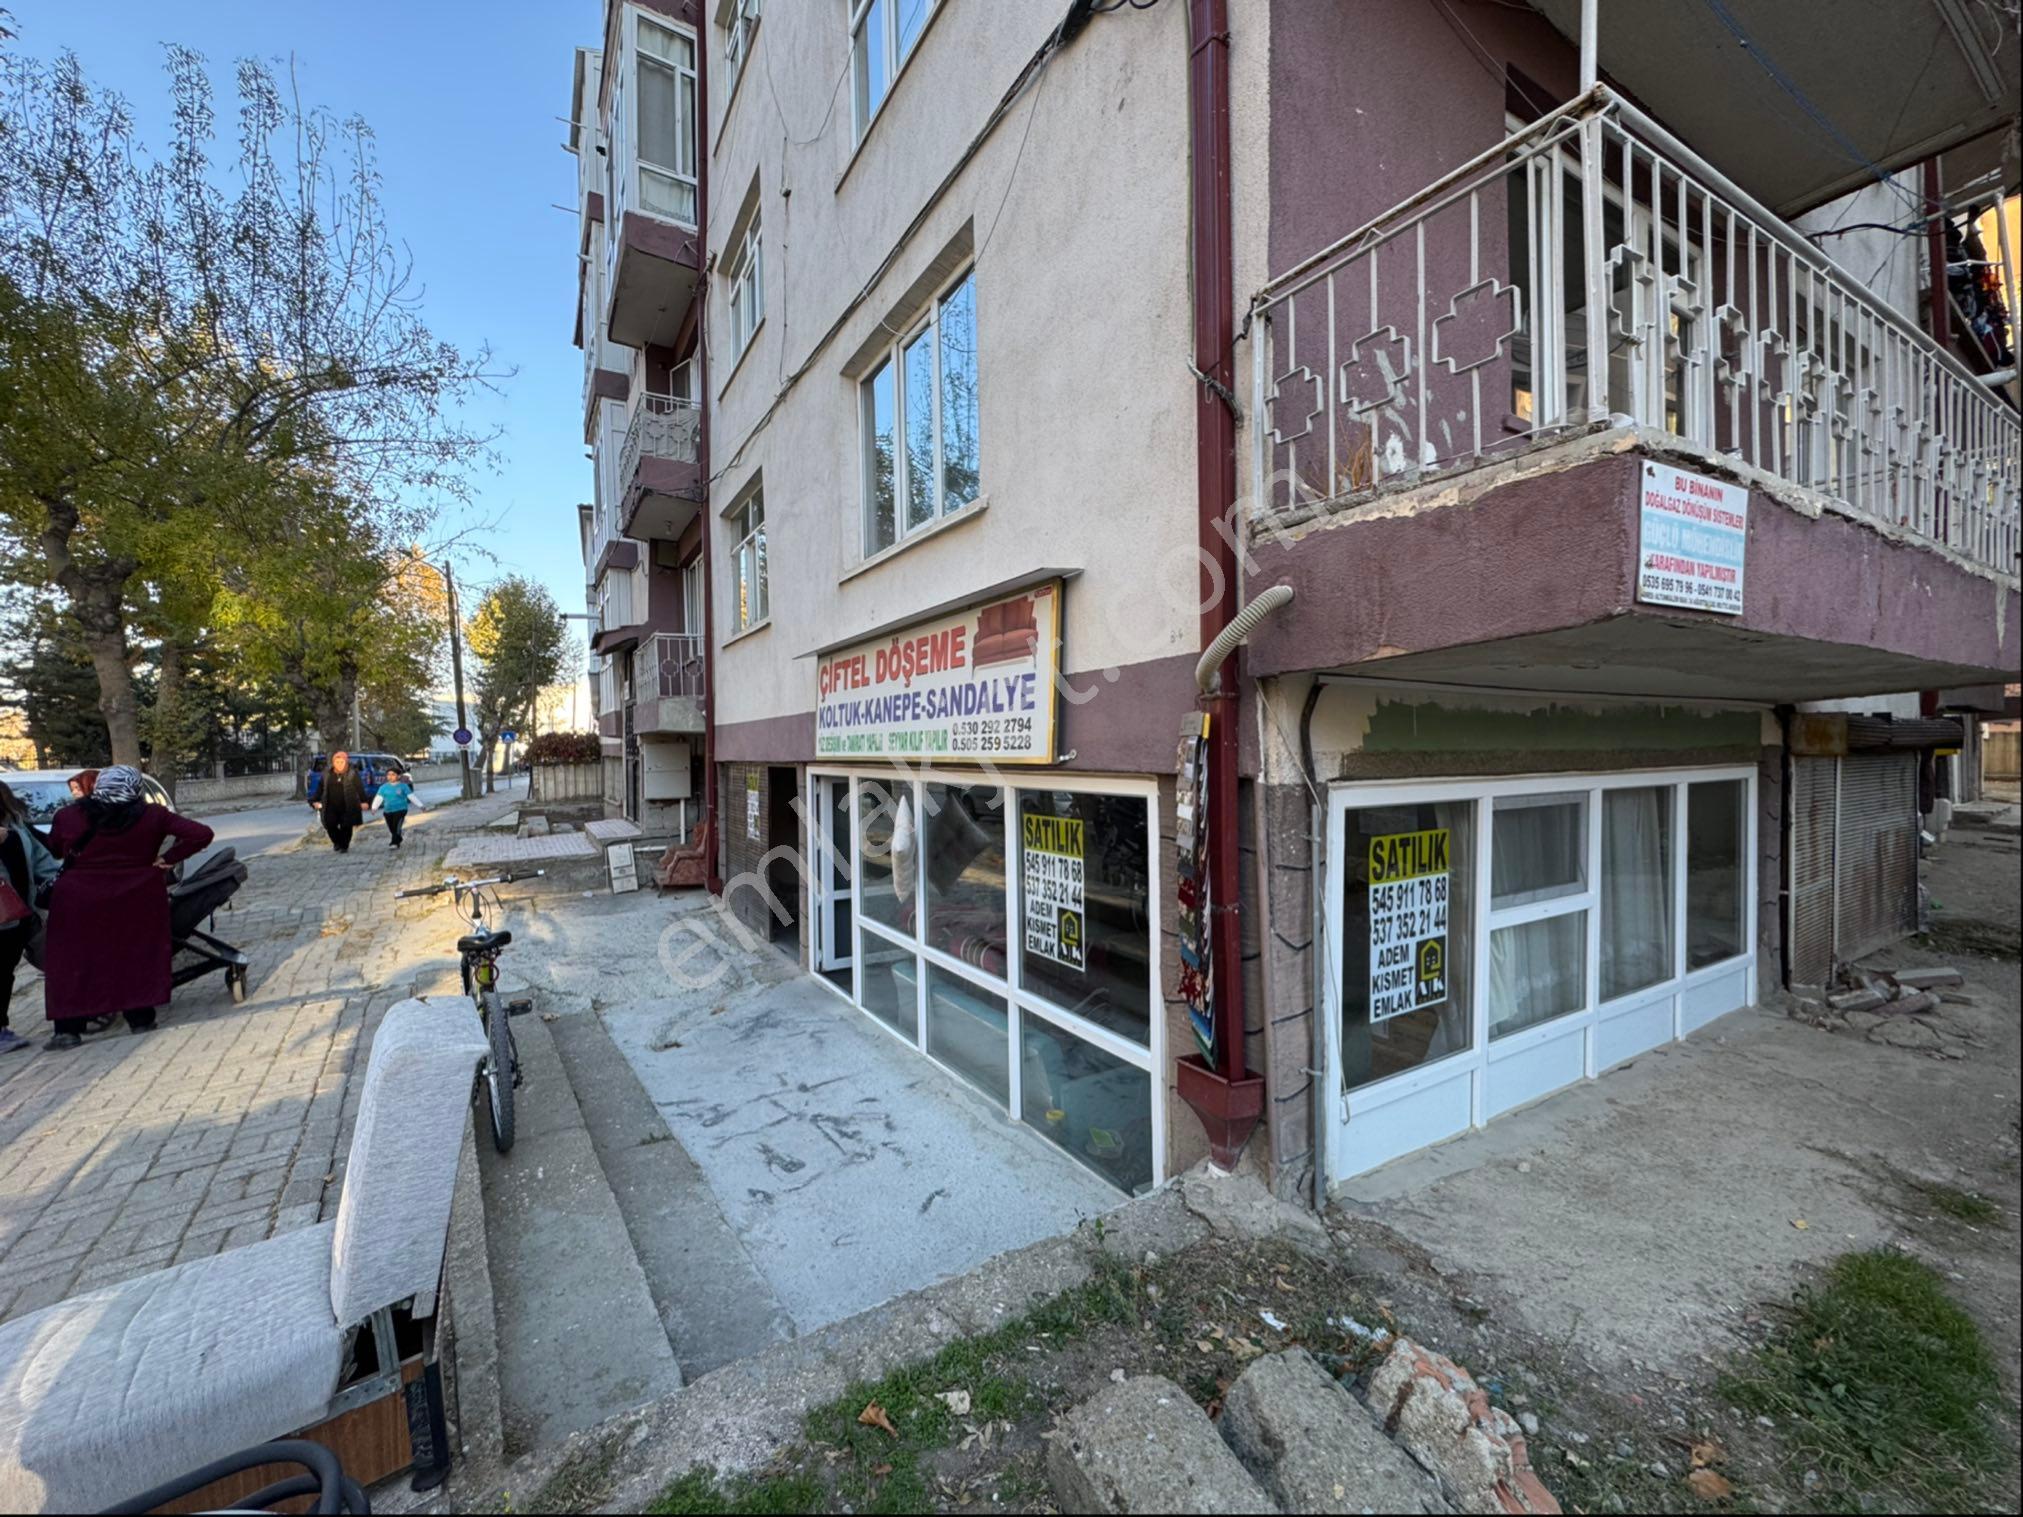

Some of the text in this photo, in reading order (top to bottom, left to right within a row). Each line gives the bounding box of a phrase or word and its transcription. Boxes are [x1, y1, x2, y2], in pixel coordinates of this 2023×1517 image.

[1675, 476, 1723, 503] BU BİNANIN
[1645, 490, 1680, 513] DOĞALGAZ
[1682, 499, 1712, 522] DÖNÜŞÜM
[1642, 574, 1659, 590] 0535
[1675, 580, 1683, 593] 79
[819, 625, 966, 702] ÇİFTEL DÖŞEME
[819, 672, 1036, 729] KOLTUK-KANEPE-SANDALYE
[952, 716, 1032, 736] 0.530 292 2794
[952, 734, 1032, 751] 0.505 259 5228
[1025, 817, 1081, 857] SATILIK
[1026, 852, 1082, 883] 545 911 78 68
[1372, 832, 1447, 881] SATILIK
[1026, 874, 1082, 909] 537 352 21 44
[1372, 876, 1447, 915] 545 911 78 68
[1030, 899, 1053, 918] ADEM
[1027, 917, 1057, 938] KISMET
[1373, 904, 1446, 946] 537 352 21 44
[1028, 935, 1056, 957] EMLAK
[1378, 943, 1409, 969] ADEM
[1372, 966, 1414, 995] KISMET
[1373, 990, 1412, 1018] EMLAK
